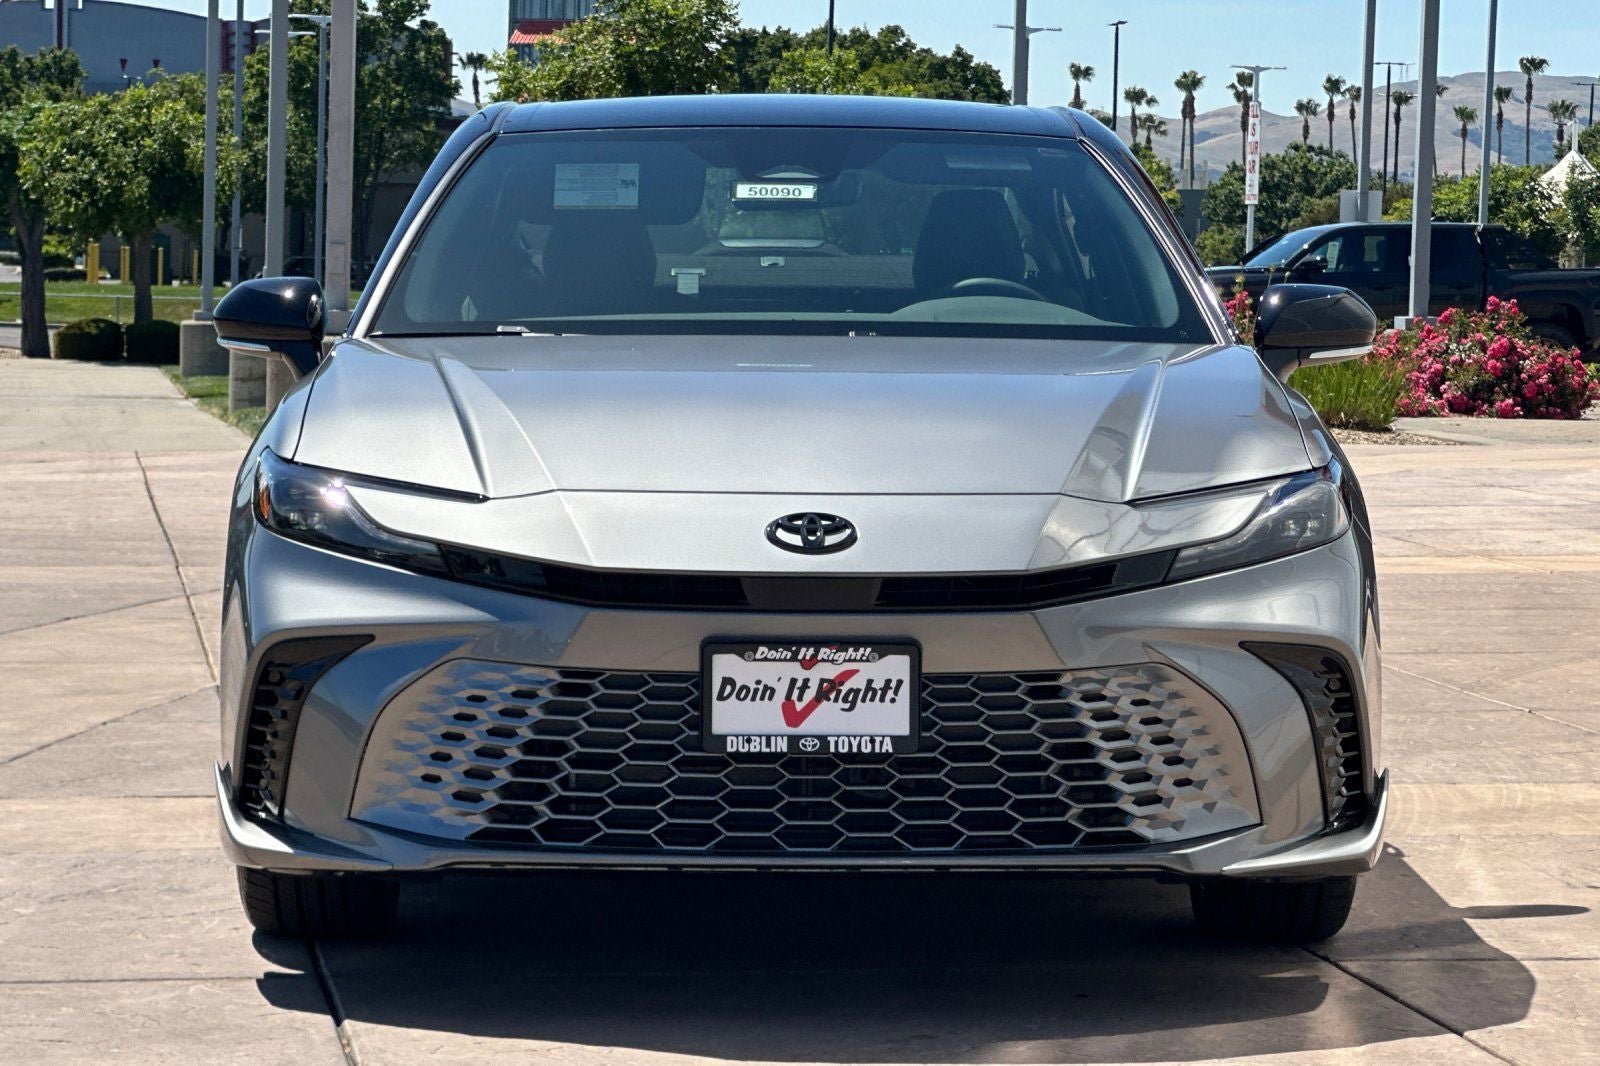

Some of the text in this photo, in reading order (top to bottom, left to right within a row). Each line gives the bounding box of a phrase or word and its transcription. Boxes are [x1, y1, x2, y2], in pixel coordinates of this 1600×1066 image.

[748, 187, 802, 197] 50090
[755, 646, 872, 665] Doin' It Right!
[716, 676, 904, 712] Doin' It Right!
[726, 736, 893, 753] DUBLIN TOYOTA
